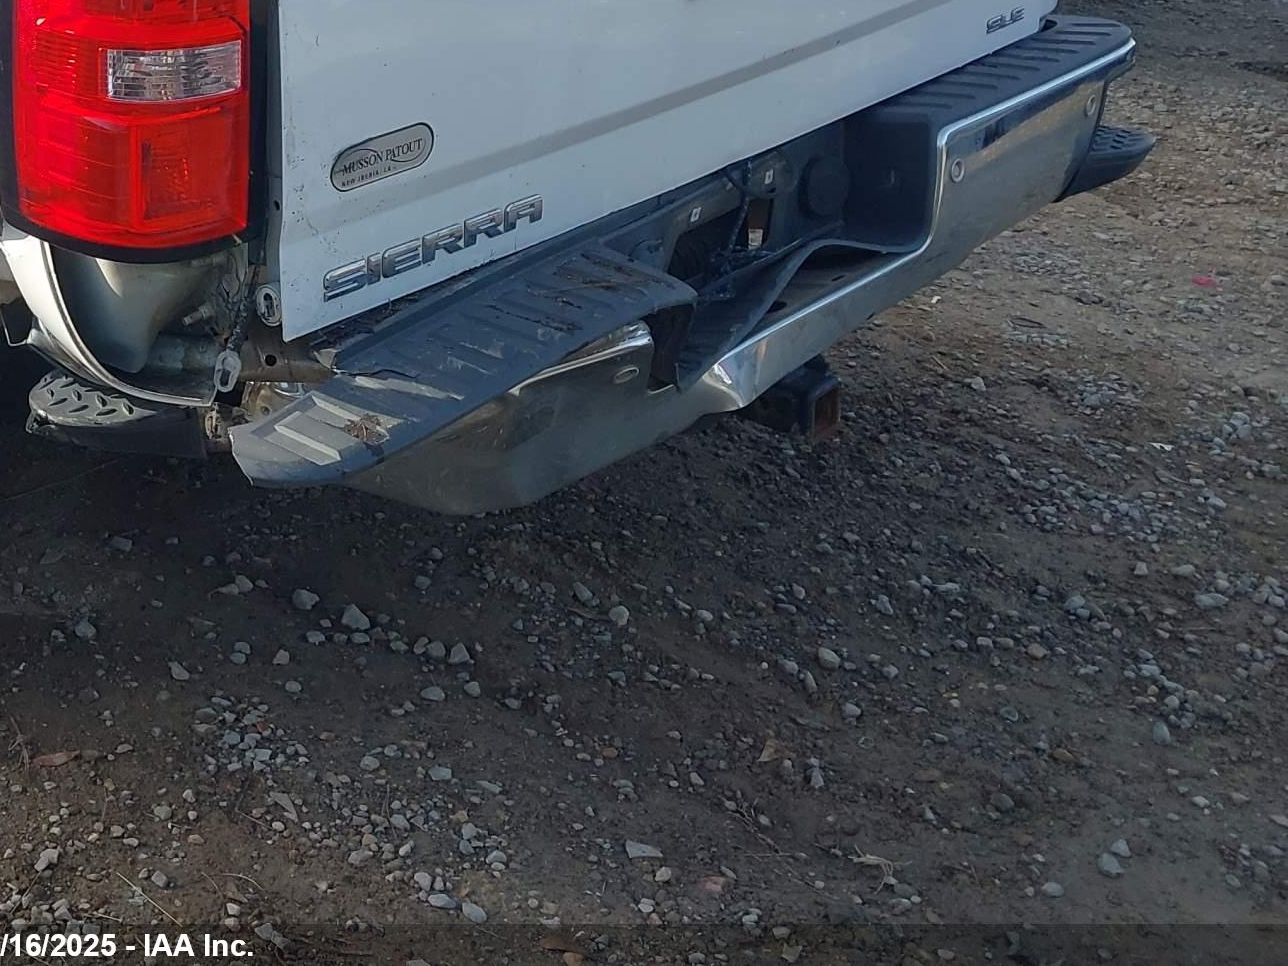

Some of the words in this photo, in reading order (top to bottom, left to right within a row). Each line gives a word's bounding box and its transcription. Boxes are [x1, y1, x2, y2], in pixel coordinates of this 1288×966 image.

[986, 6, 1025, 34] SLE
[342, 150, 384, 176] MUSSON
[385, 138, 423, 162] PATOUT
[323, 194, 543, 302] SIERRA
